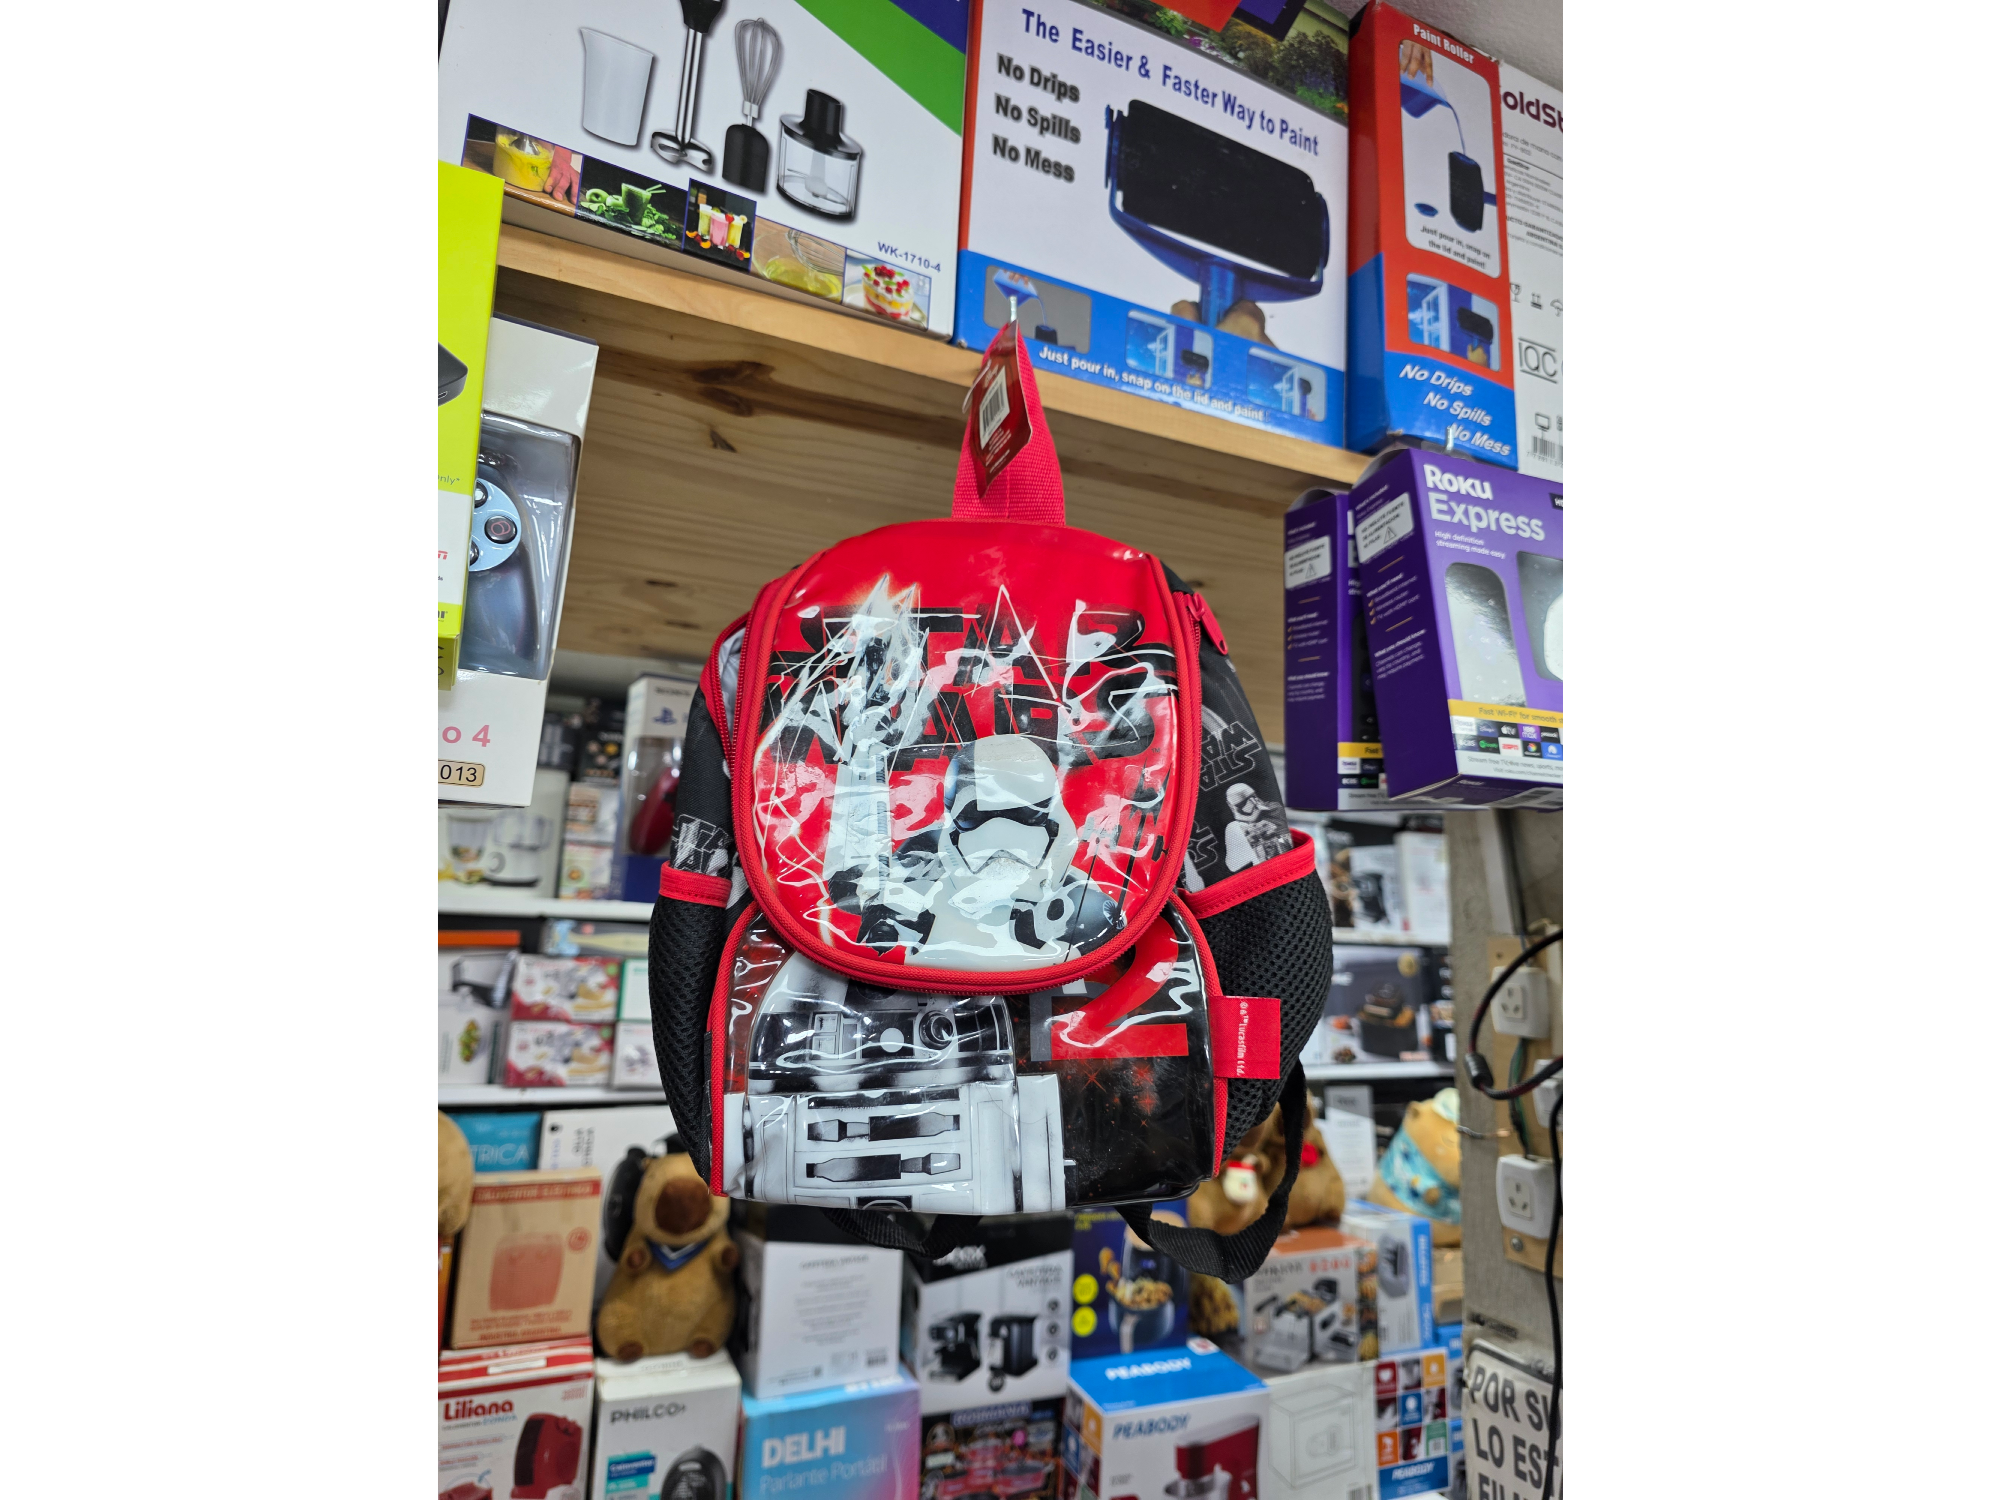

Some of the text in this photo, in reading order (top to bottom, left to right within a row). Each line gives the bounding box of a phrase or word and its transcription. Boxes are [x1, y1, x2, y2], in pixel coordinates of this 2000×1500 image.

[1413, 23, 1475, 64] Paint Roller
[997, 52, 1081, 103] No Drips
[1021, 8, 1320, 157] The Easier & Faster Way to Paint
[994, 92, 1082, 145] No Spills
[991, 133, 1076, 184] No Mess
[877, 241, 941, 273] WK-1710-4
[1420, 225, 1439, 237] Just
[1439, 232, 1455, 243] pour
[1465, 243, 1481, 256] snap
[1482, 250, 1490, 259] on
[1428, 239, 1441, 250] the
[1442, 245, 1451, 254] lid
[1452, 250, 1465, 260] and
[1519, 341, 1558, 378] IQC
[1039, 346, 1069, 366] Just
[1071, 358, 1101, 376] pour
[1103, 363, 1120, 382] in,
[1122, 371, 1152, 391] snap
[1154, 381, 1170, 394] on
[1172, 384, 1191, 401] the
[1194, 391, 1209, 406] lid
[1211, 397, 1232, 412] and
[1399, 363, 1474, 396] No Drips
[1423, 391, 1492, 427] No Spills
[1447, 423, 1511, 456] No Mess
[1428, 491, 1545, 541] Express
[1435, 531, 1484, 546] High definition
[1436, 540, 1505, 559] streaming made easy
[1478, 707, 1494, 716] Fast
[1519, 711, 1530, 720] for
[1531, 714, 1557, 724] smooth
[472, 724, 491, 747] 4
[1105, 1357, 1192, 1381] PEABODY
[443, 1398, 514, 1421] Liliana
[1469, 1365, 1521, 1423] POR
[610, 1402, 682, 1425] PHILCO
[1112, 1413, 1192, 1440] PEABODY
[761, 1425, 846, 1469] DELHI
[1472, 1418, 1505, 1469] LO
[760, 1467, 829, 1494] Parlante
